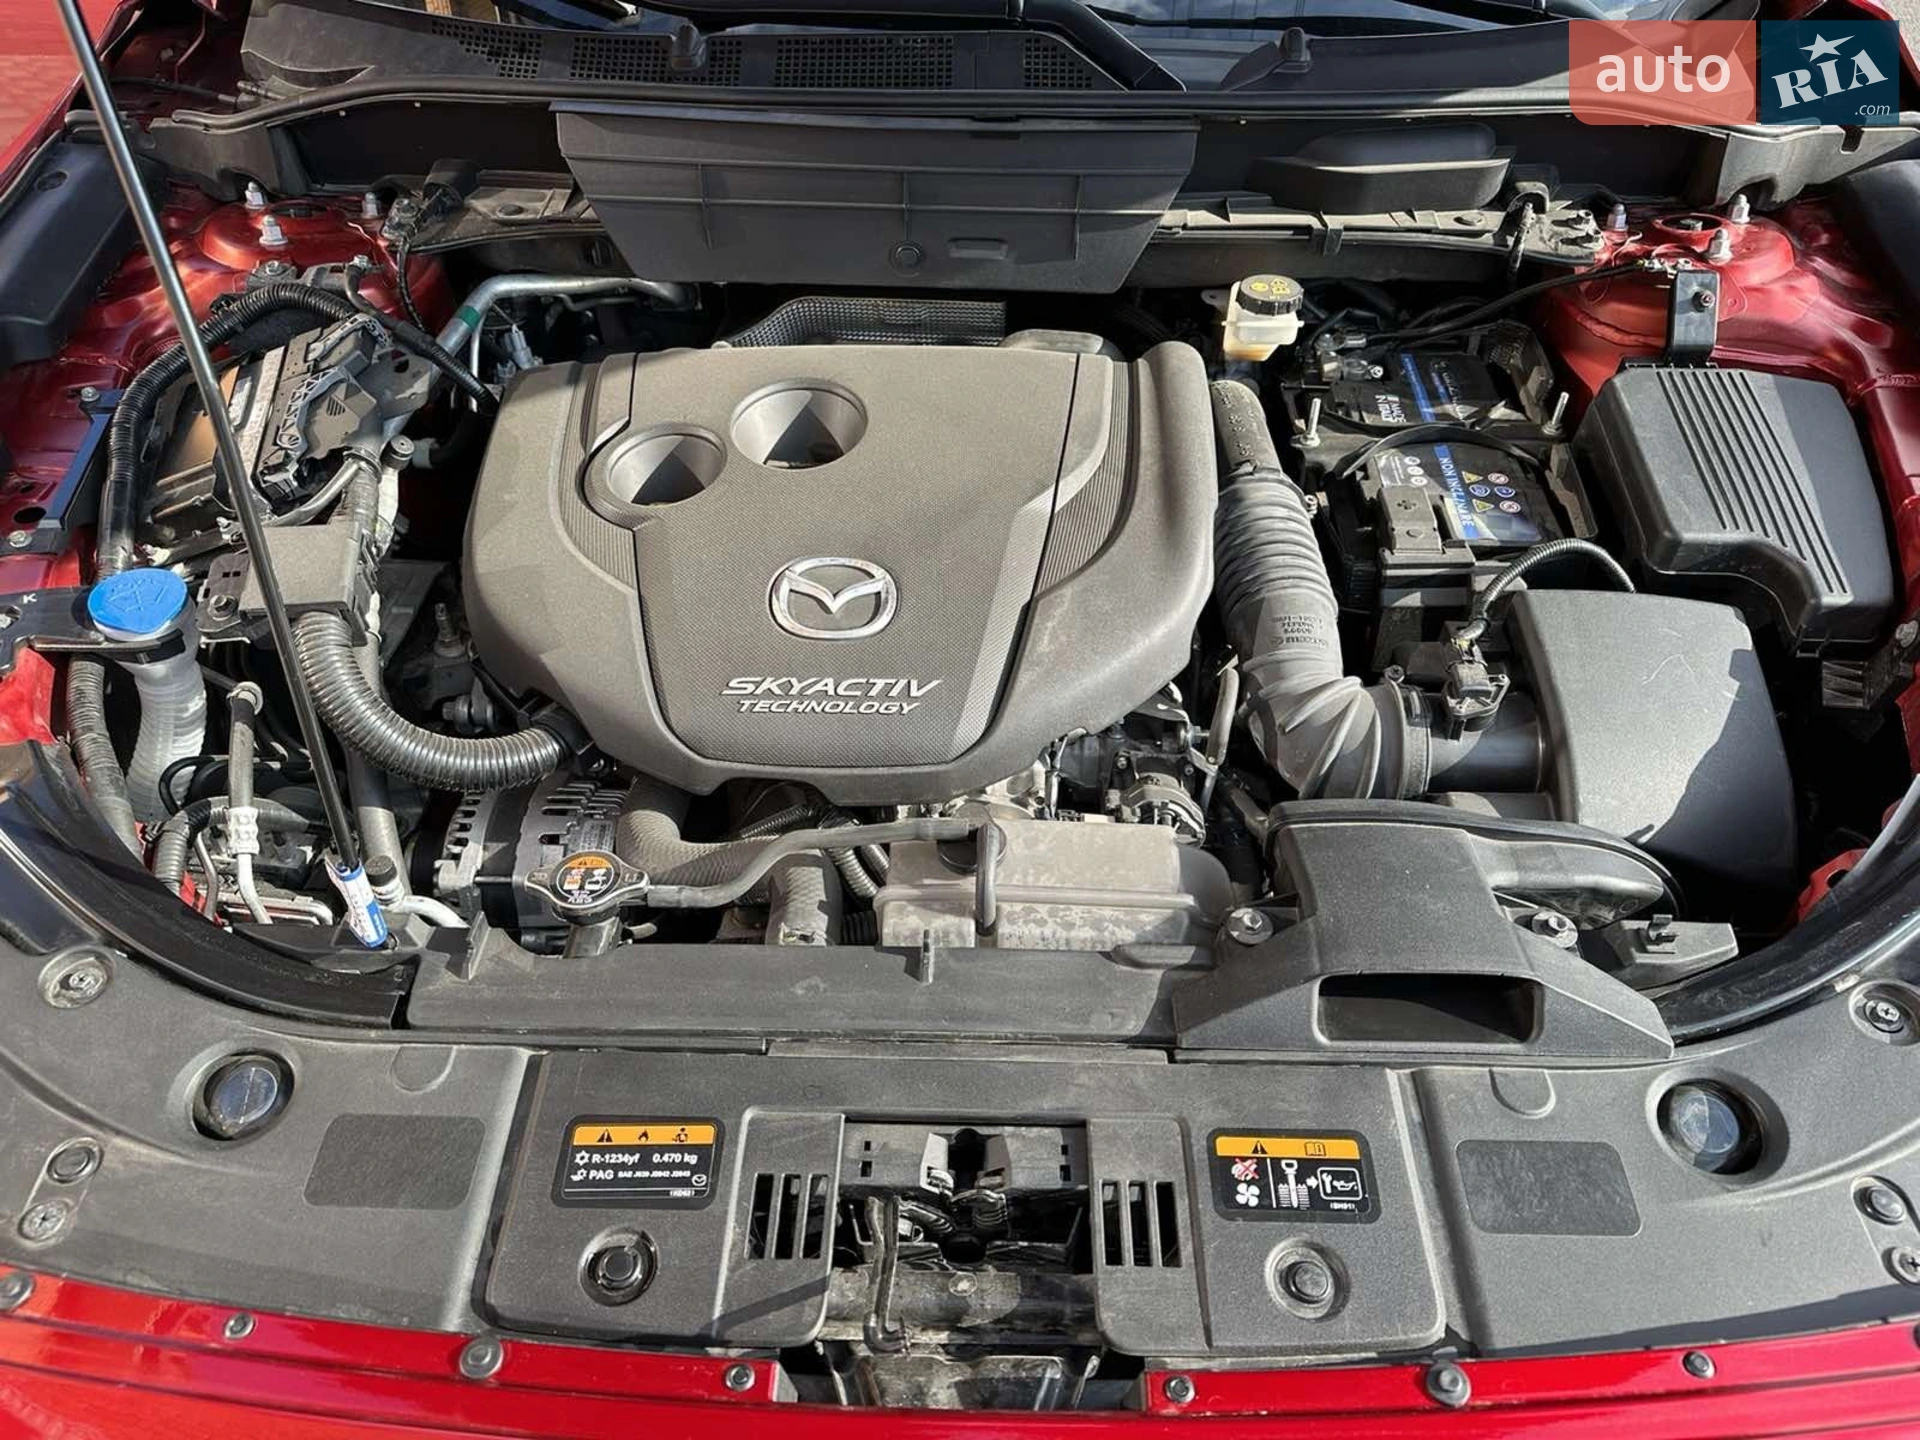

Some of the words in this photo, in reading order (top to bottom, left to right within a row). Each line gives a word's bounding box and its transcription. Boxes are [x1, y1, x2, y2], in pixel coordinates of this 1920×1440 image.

[1440, 456, 1459, 477] NON
[721, 677, 942, 697] SKYACTIV
[739, 700, 920, 714] TECHNOLOGY
[592, 1153, 640, 1165] R-1234yf
[652, 1153, 682, 1163] 0.470
[683, 1153, 698, 1164] kg
[588, 1169, 614, 1180] PAG
